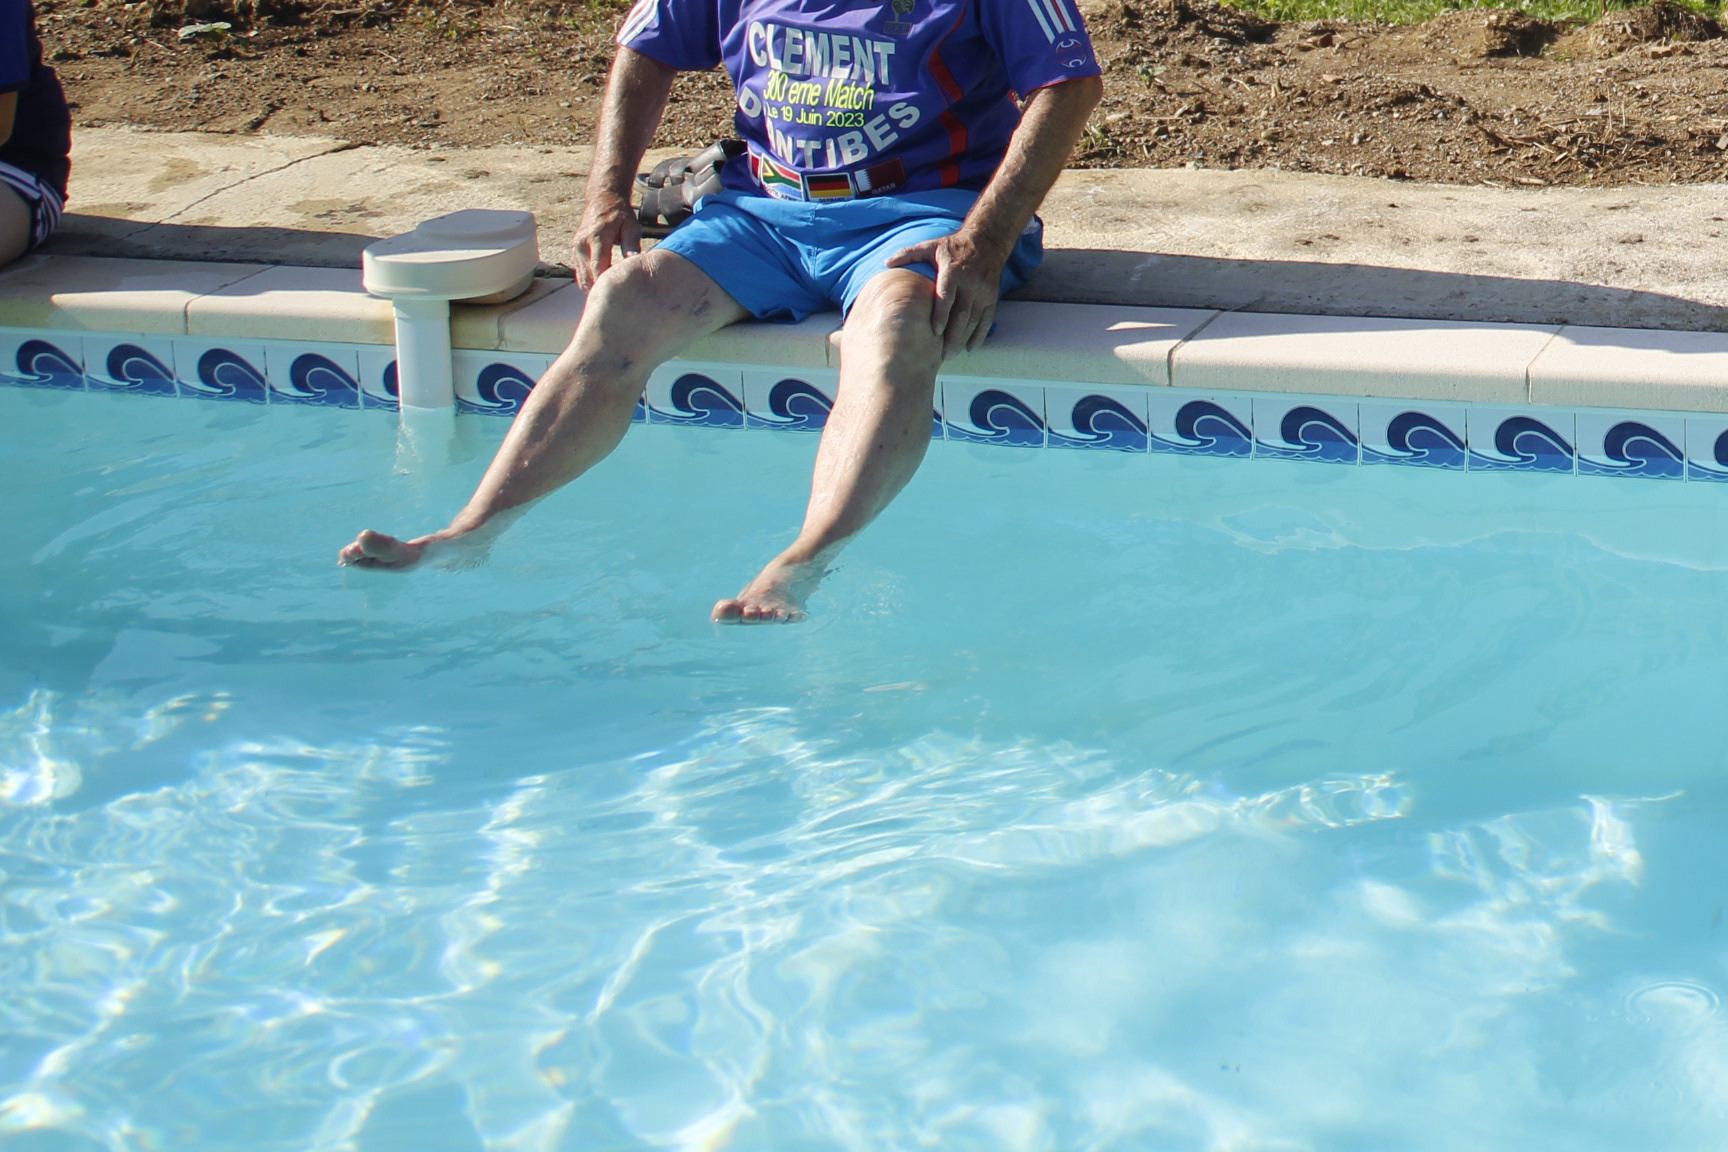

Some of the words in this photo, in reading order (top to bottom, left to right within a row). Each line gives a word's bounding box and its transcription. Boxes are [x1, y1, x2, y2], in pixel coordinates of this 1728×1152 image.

[749, 21, 896, 85] CLEMENT
[824, 78, 875, 110] Match
[780, 105, 793, 122] 19
[796, 108, 822, 126] Juin
[826, 111, 865, 128] 2023
[871, 183, 897, 196] QATAR
